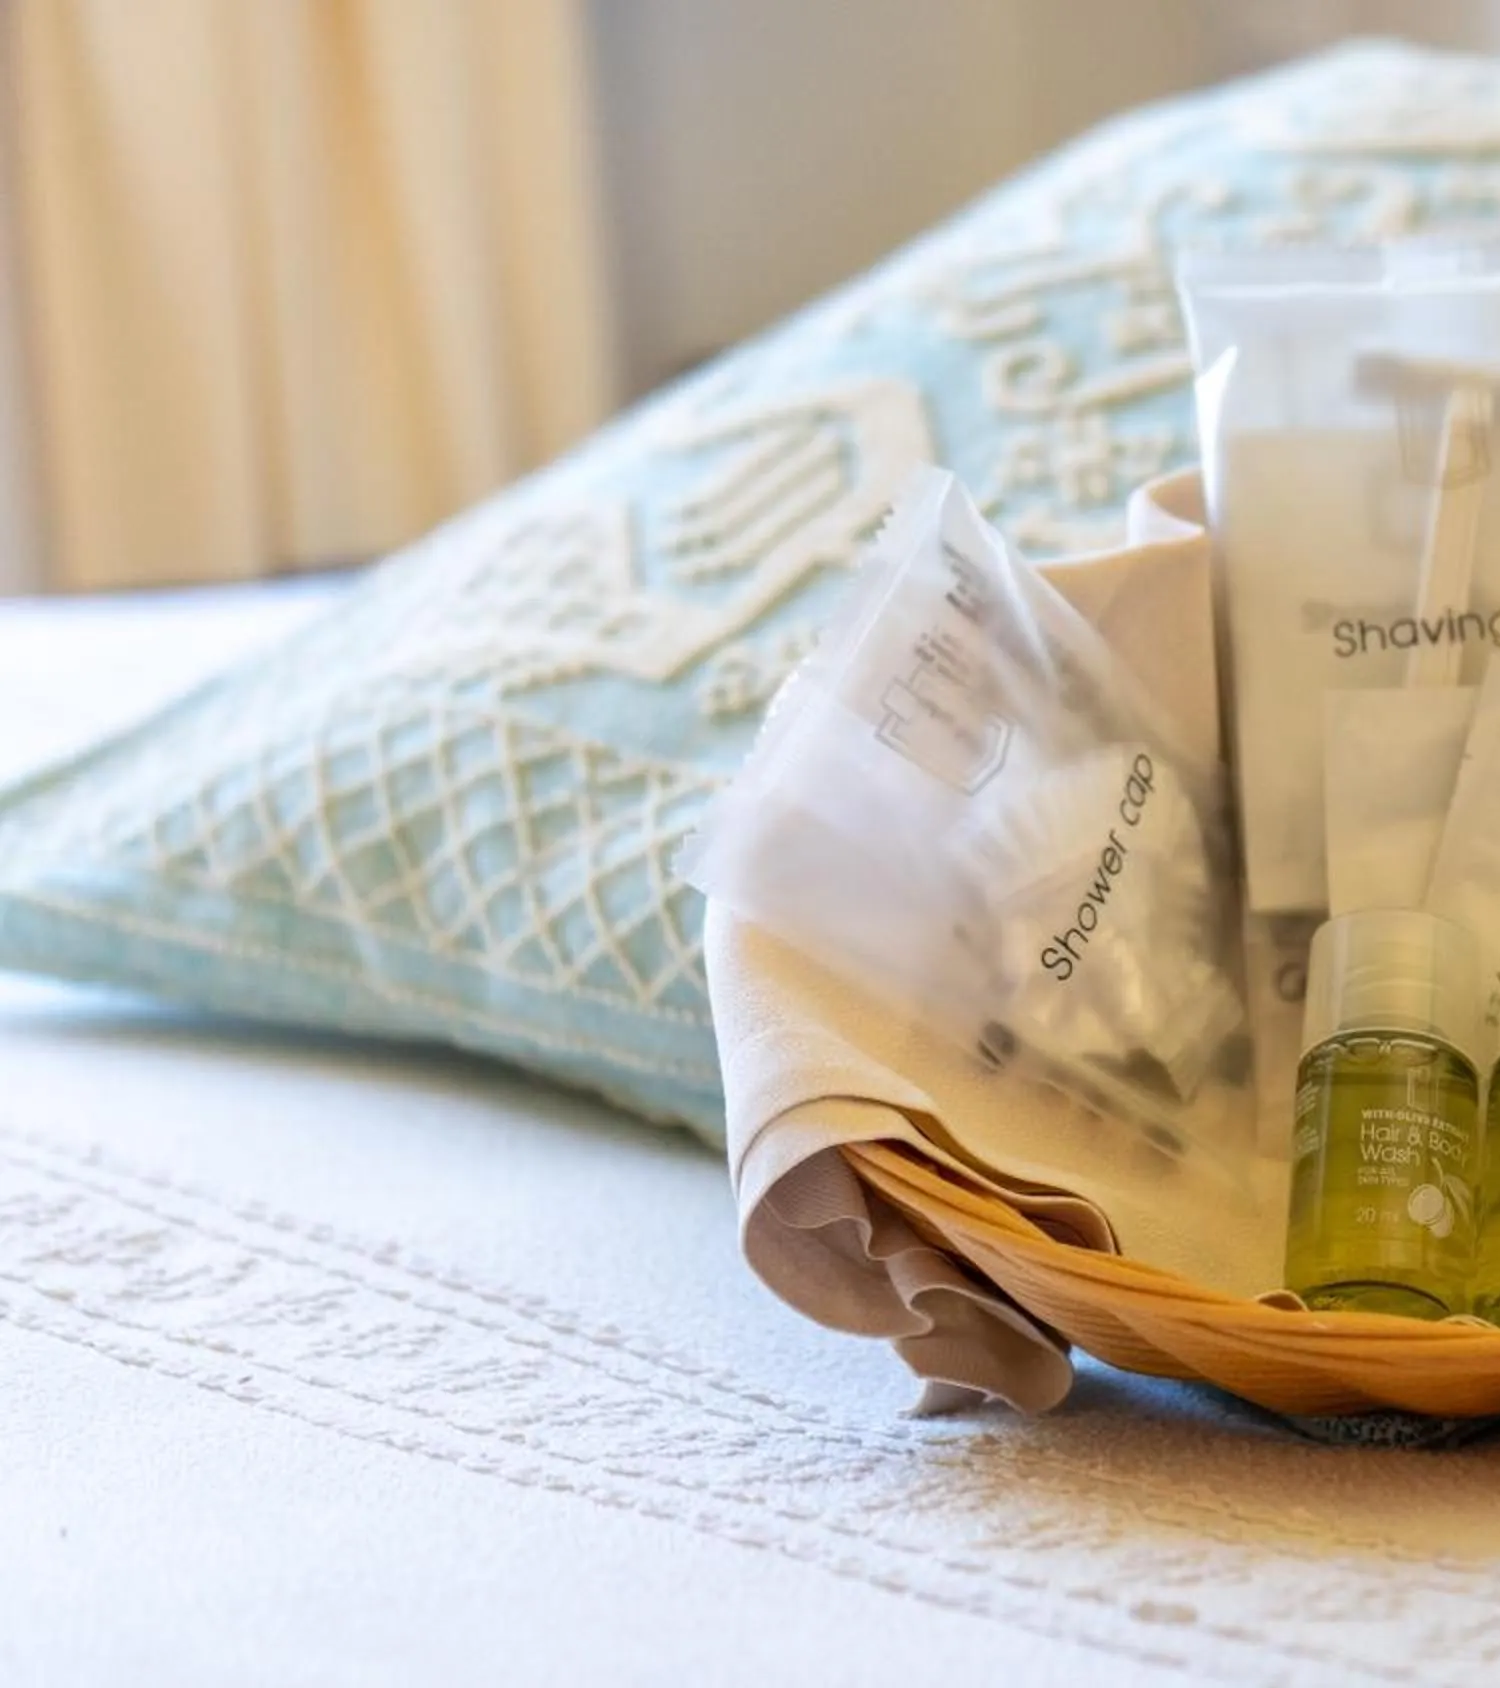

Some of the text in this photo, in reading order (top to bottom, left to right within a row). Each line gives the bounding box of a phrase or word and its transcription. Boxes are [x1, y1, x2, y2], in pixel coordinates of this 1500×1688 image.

[1040, 753, 1156, 981] Shower cap
[1361, 1109, 1394, 1120] WITH
[1396, 1109, 1431, 1126] OLIVE
[1360, 1143, 1421, 1167] Wash
[1361, 1122, 1468, 1169] Hair & Body
[1356, 1206, 1377, 1224] 20
